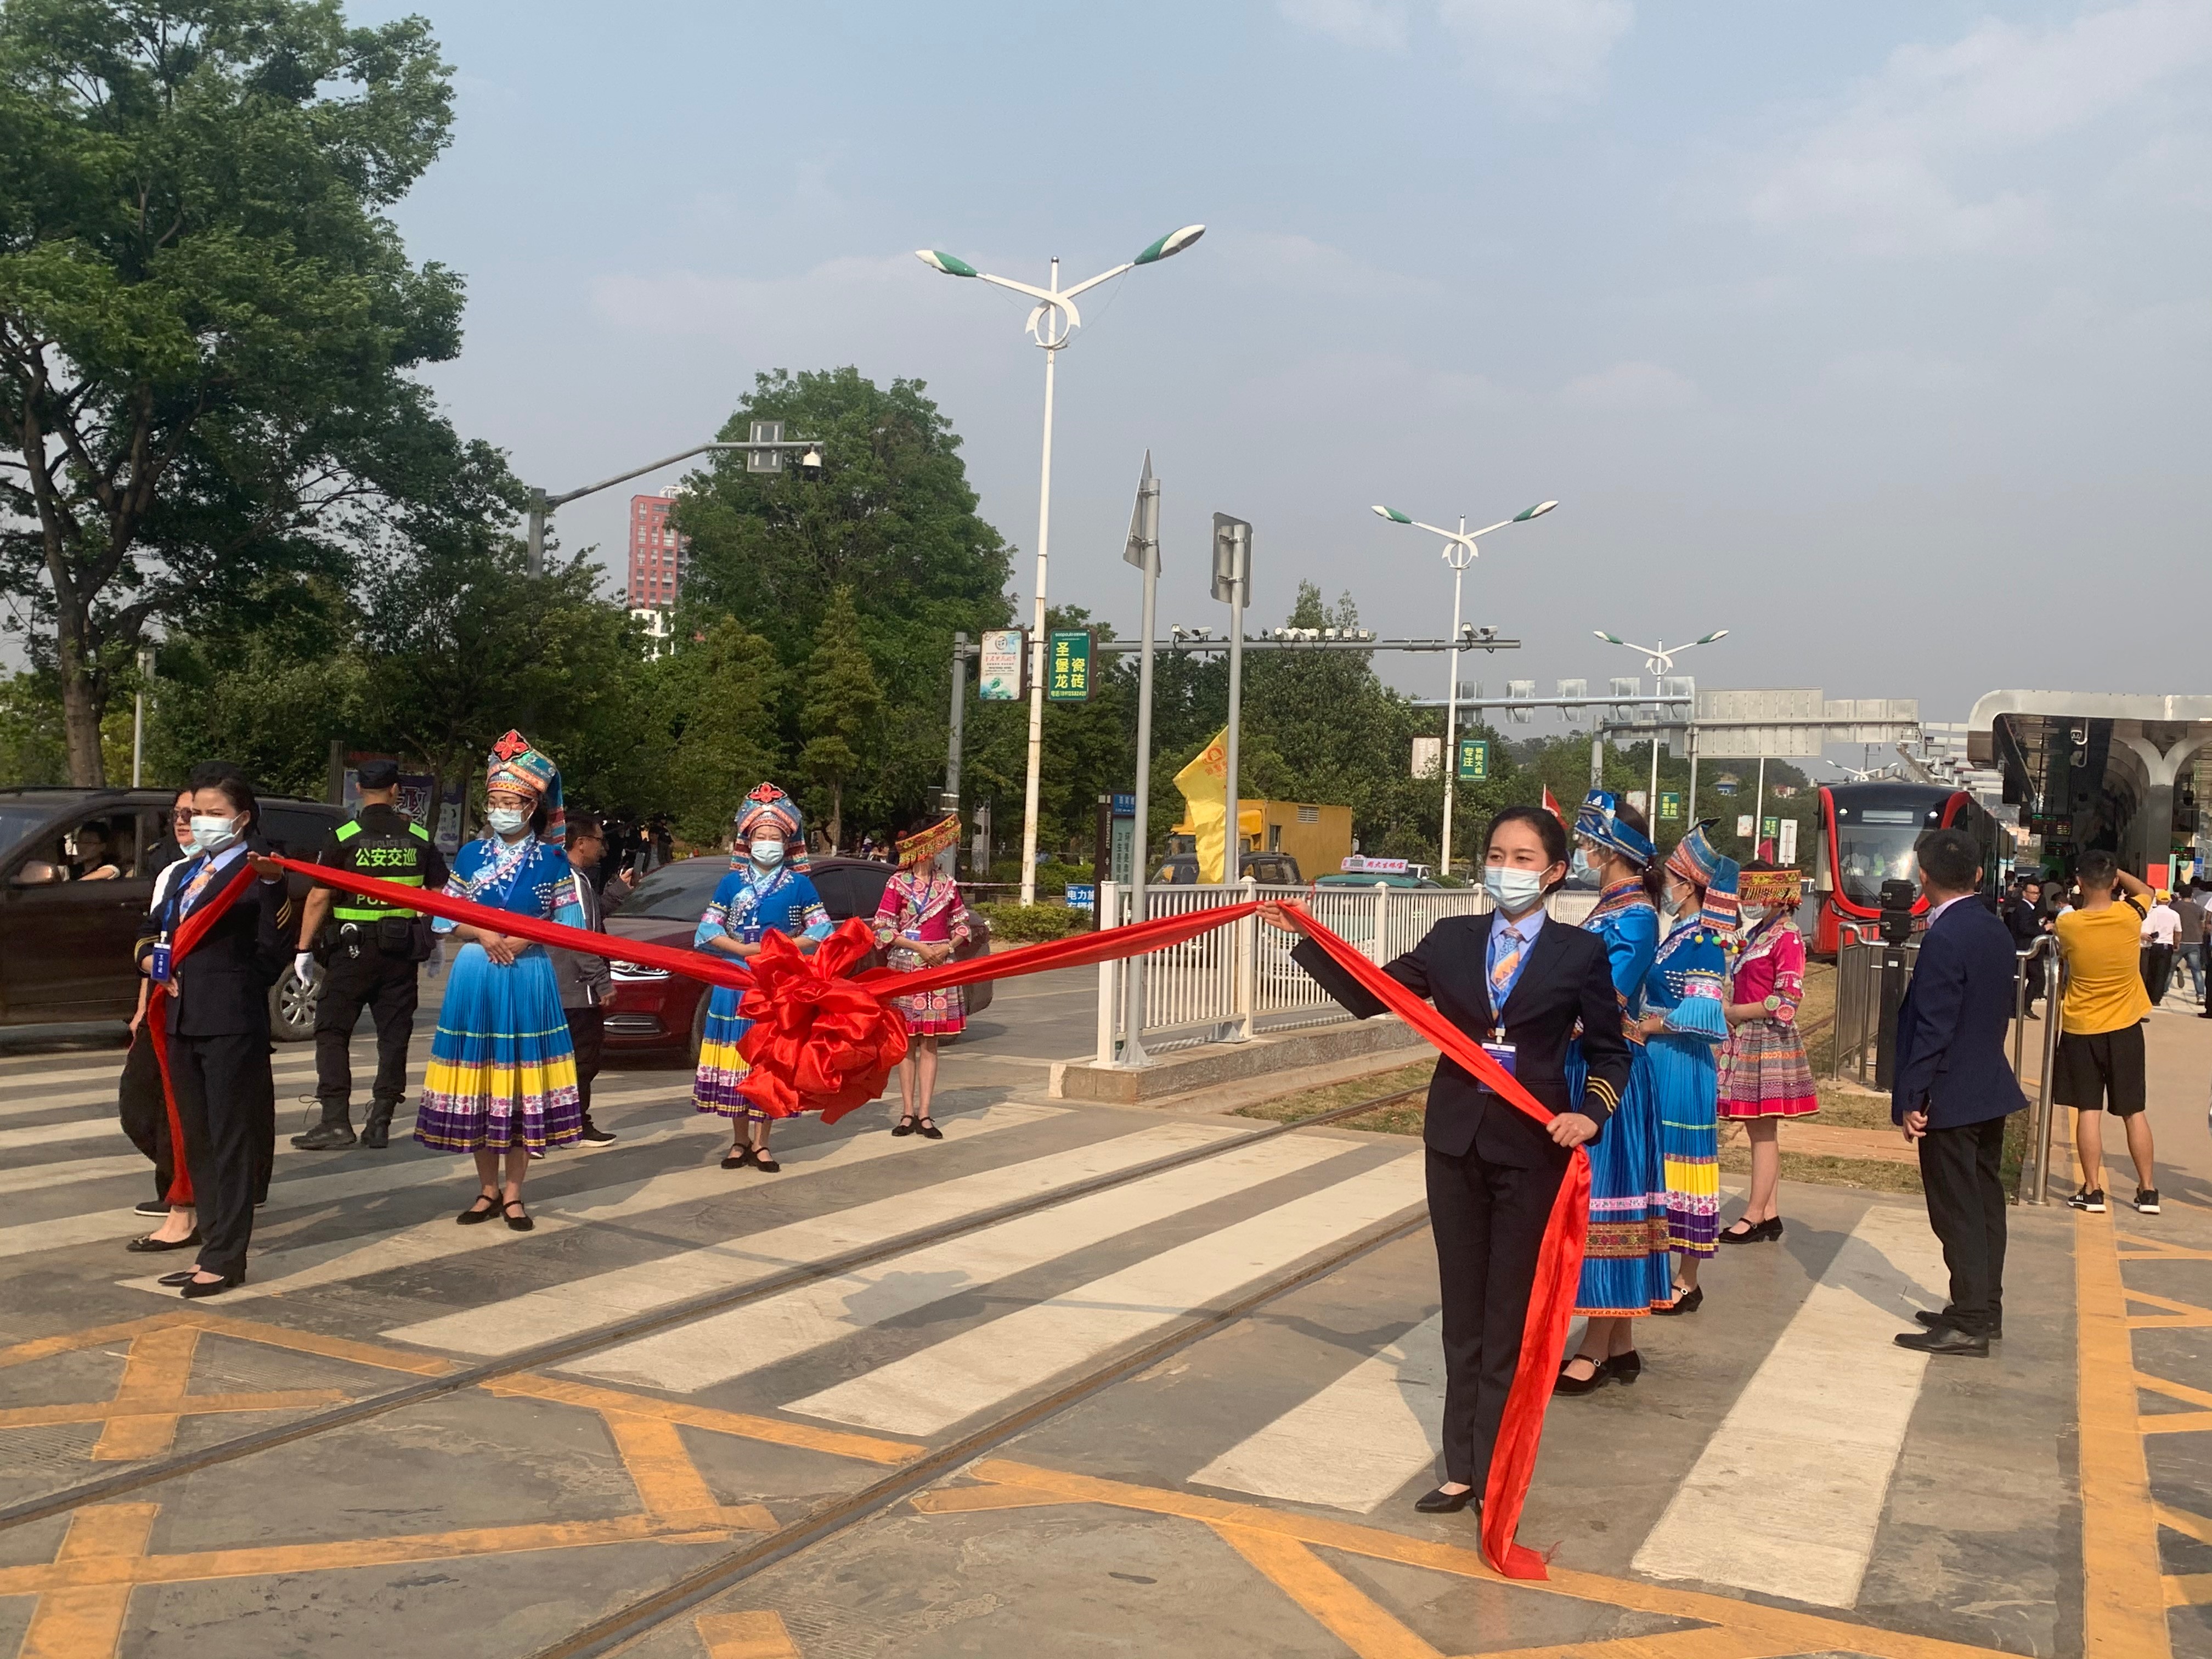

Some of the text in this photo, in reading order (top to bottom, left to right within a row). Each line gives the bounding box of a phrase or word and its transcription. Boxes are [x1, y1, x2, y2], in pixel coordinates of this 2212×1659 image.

[1054, 642, 1069, 689] 圣堡龙
[1070, 658, 1085, 689] 瓷砖
[356, 848, 416, 867] 公安交巡
